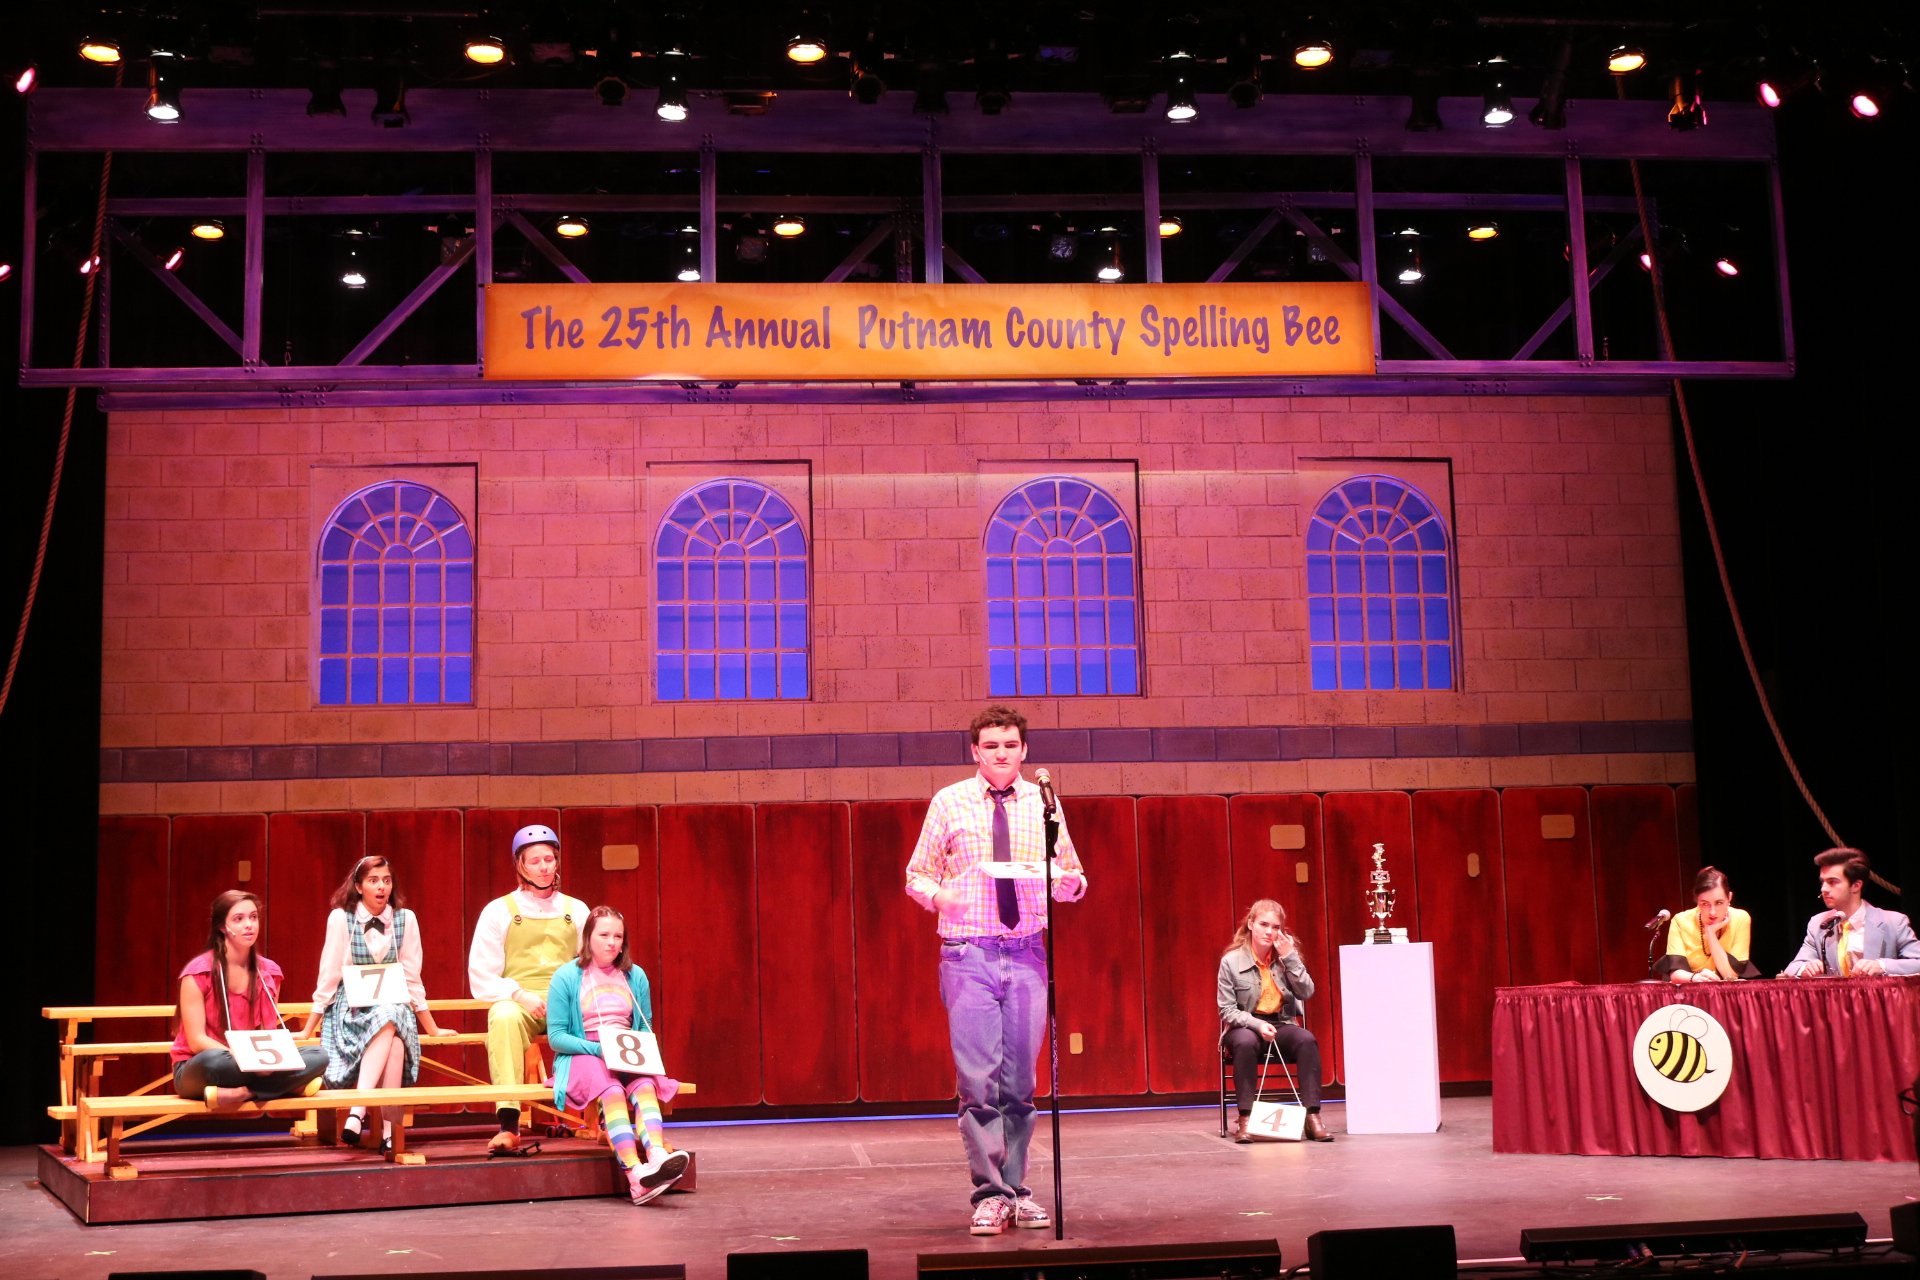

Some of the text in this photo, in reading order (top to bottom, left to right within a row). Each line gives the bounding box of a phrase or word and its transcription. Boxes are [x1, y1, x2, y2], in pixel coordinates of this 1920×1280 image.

[520, 304, 1342, 356] The 25th Annual Putnam County Spelling Bee
[361, 968, 386, 1000] 7
[249, 1034, 283, 1065] 5
[616, 1033, 646, 1067] 8
[1261, 1108, 1287, 1132] 4
